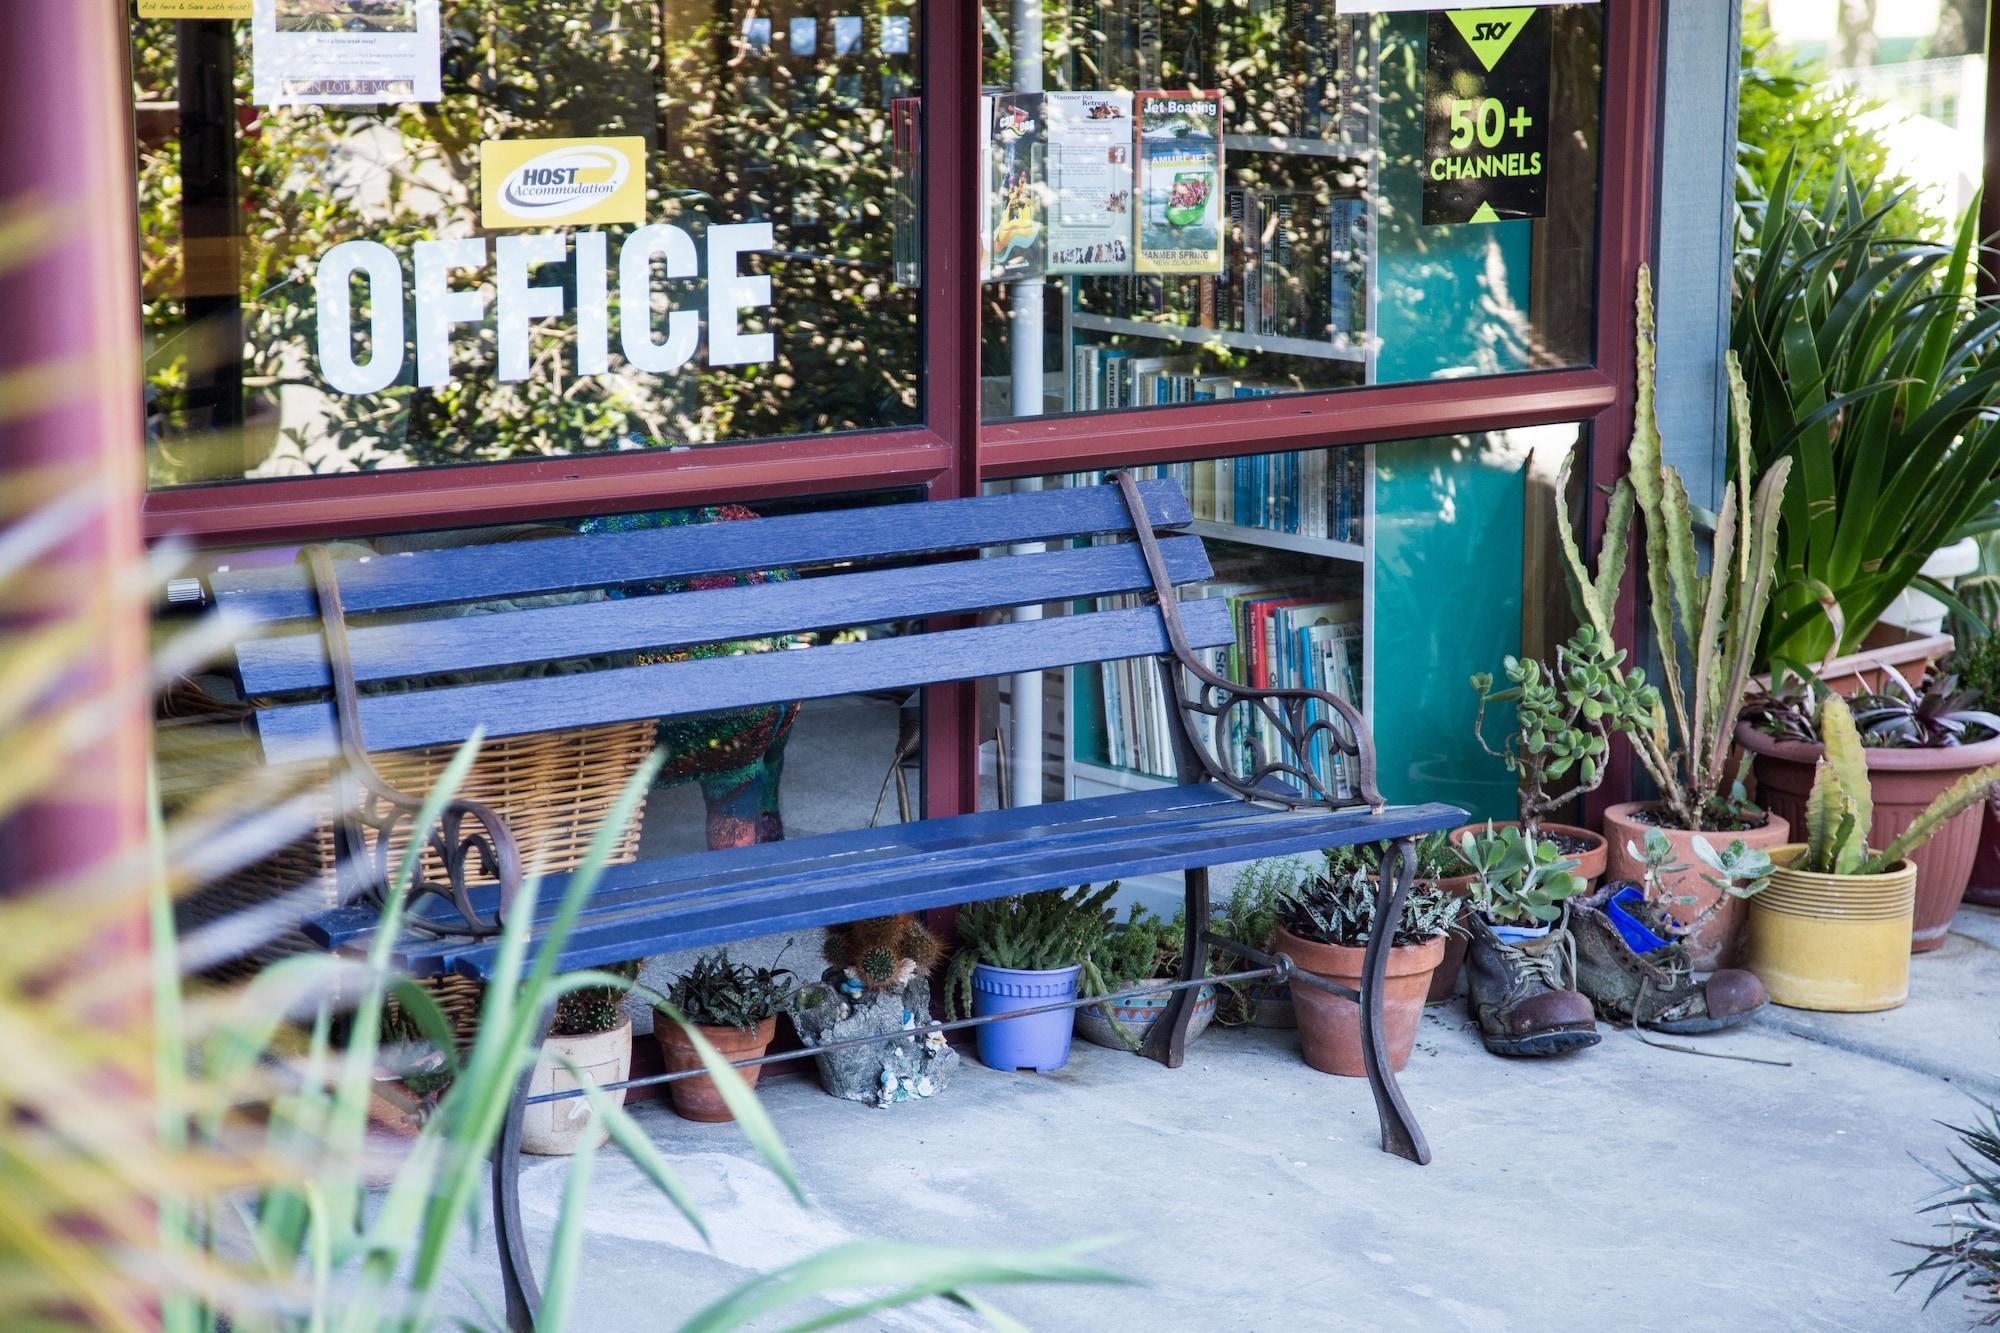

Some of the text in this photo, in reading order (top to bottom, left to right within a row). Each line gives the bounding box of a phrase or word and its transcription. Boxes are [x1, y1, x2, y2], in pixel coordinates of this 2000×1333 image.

[1472, 22, 1512, 41] SKY
[1144, 101, 1217, 116] Jet Boating
[1449, 98, 1533, 150] 50+
[1430, 152, 1542, 181] CHANNELS
[522, 167, 579, 186] HOST
[513, 182, 614, 197] Accommodation
[1141, 250, 1209, 259] HANMER SPRING
[316, 222, 775, 395] OFFICE
